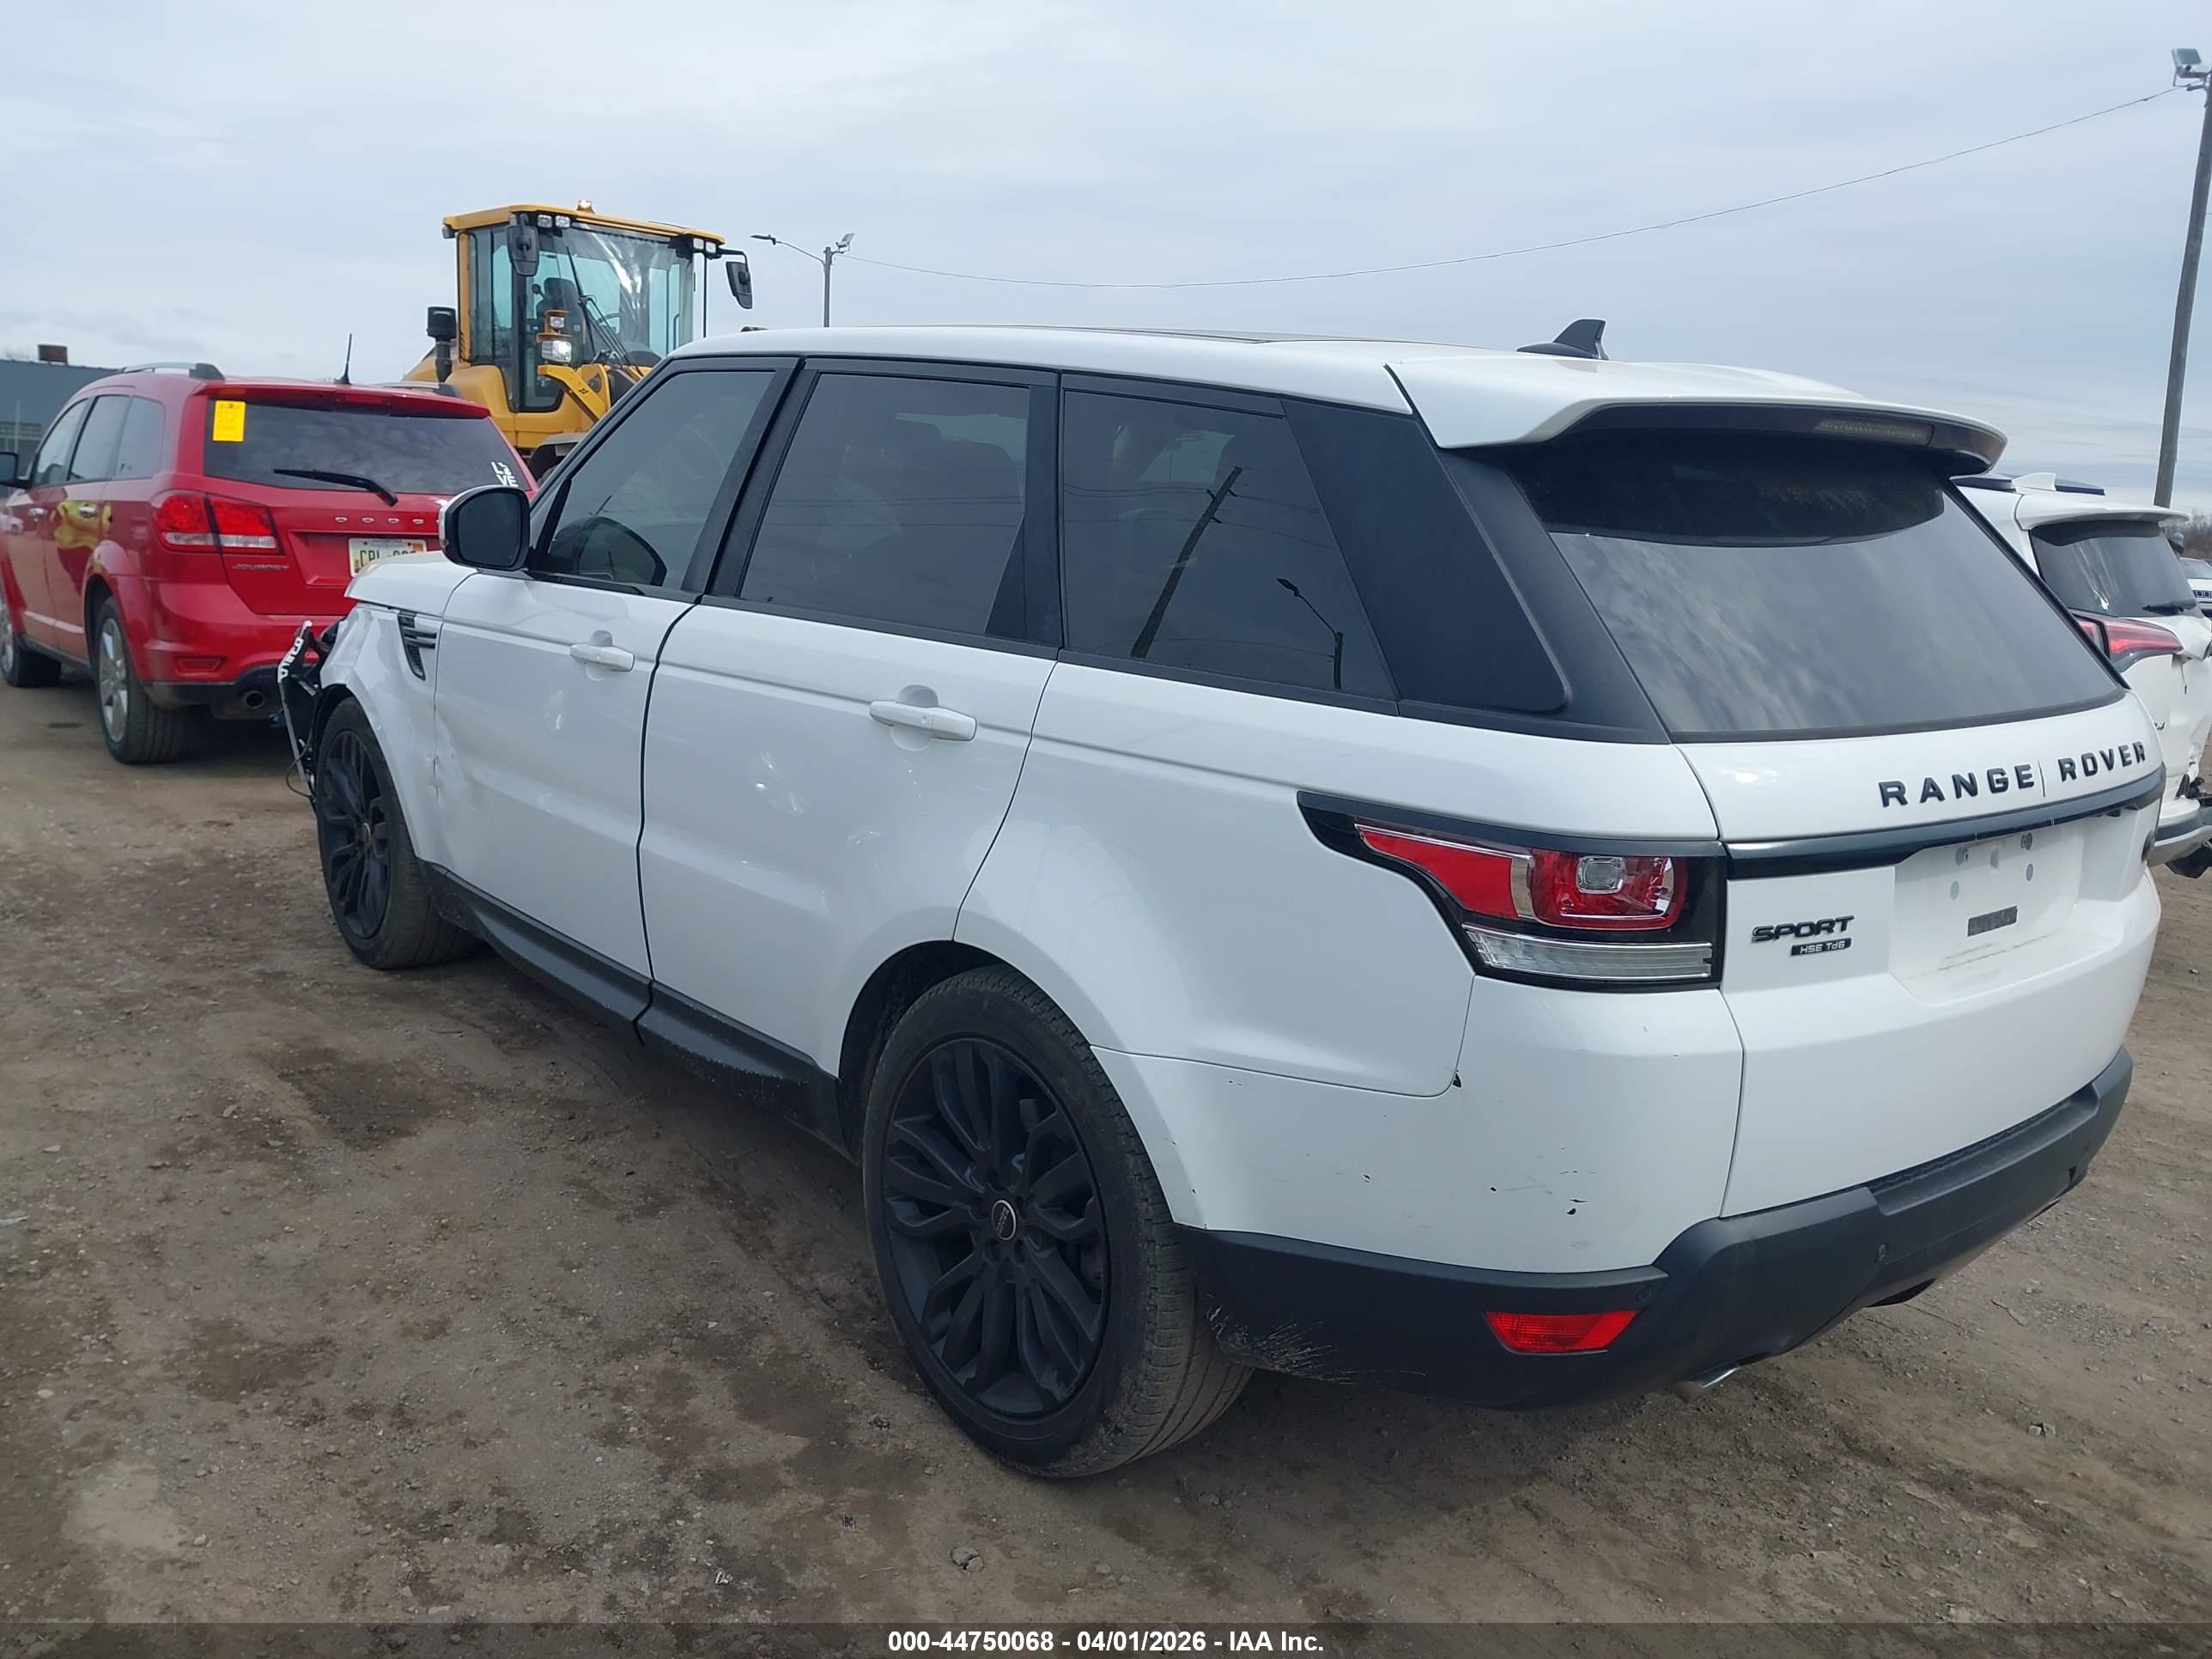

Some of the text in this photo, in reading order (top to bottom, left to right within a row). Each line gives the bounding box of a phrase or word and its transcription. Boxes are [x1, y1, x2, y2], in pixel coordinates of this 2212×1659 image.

[1878, 740, 2147, 808] RANGE ROVER
[1751, 915, 1856, 942] SPORT
[1800, 944, 1823, 954] HSE
